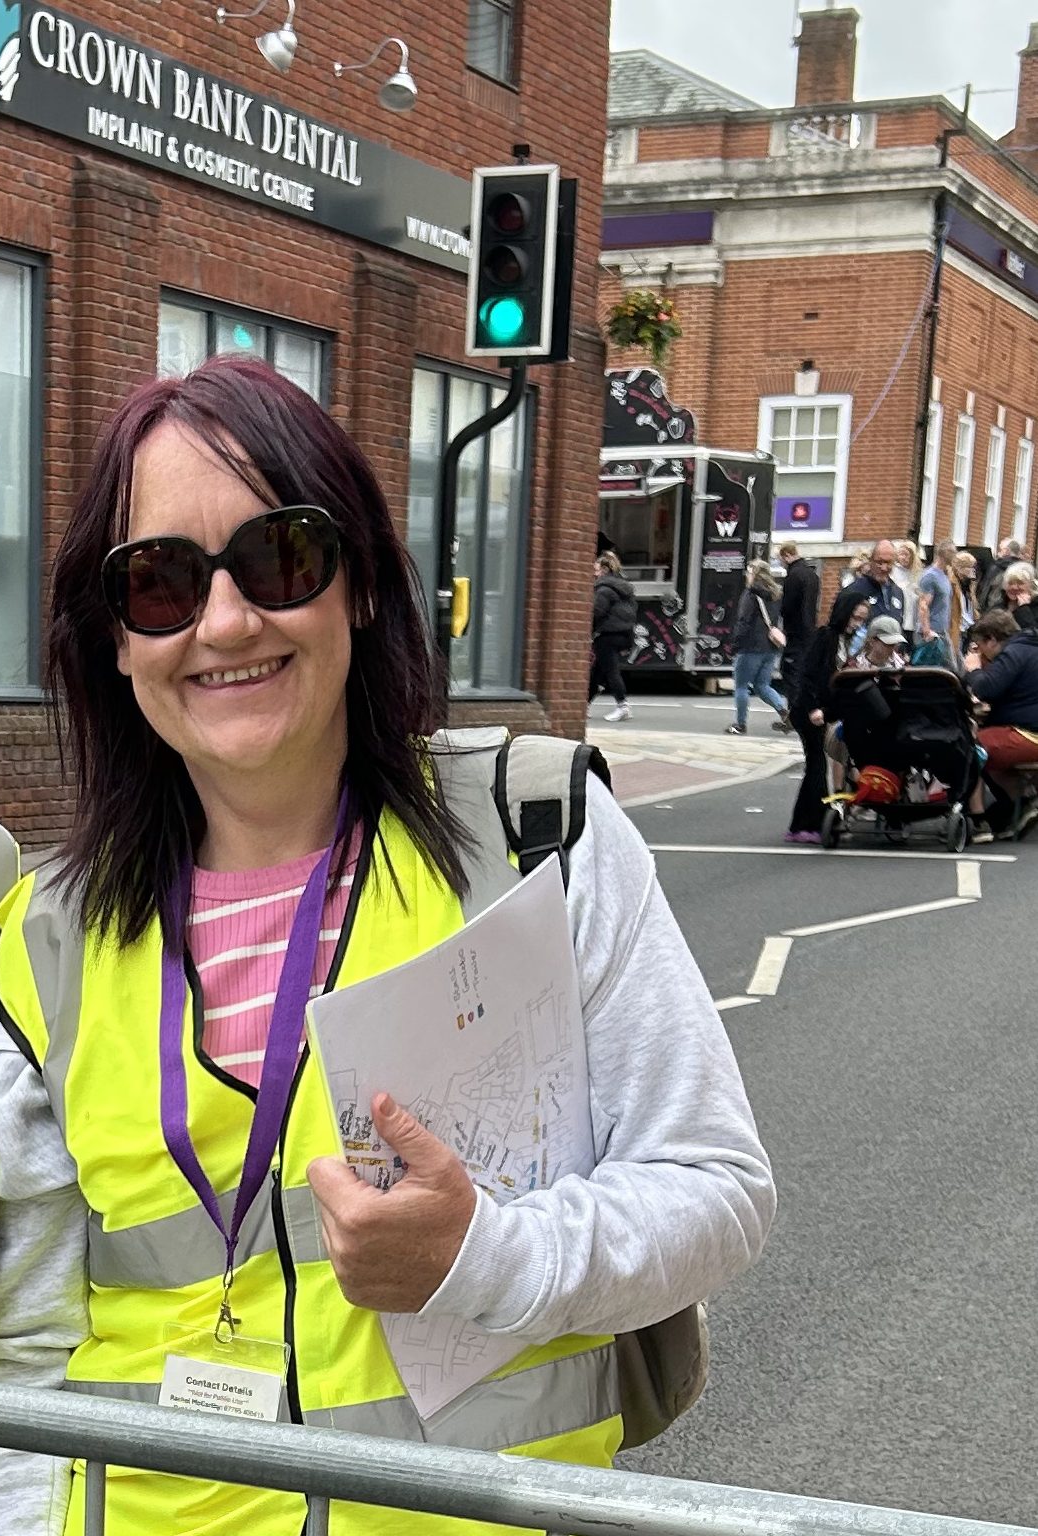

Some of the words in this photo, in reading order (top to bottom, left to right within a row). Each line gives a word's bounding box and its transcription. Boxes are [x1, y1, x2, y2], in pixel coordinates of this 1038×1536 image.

[28, 11, 162, 110] CROWN
[173, 68, 255, 146] BANK
[262, 104, 362, 187] DENTAL
[88, 106, 165, 157] IMPLANT
[166, 135, 180, 163] &
[184, 143, 260, 192] COSMETIC
[263, 171, 315, 212] CENTRE
[186, 1376, 221, 1391] Contact
[222, 1382, 253, 1397] Details
